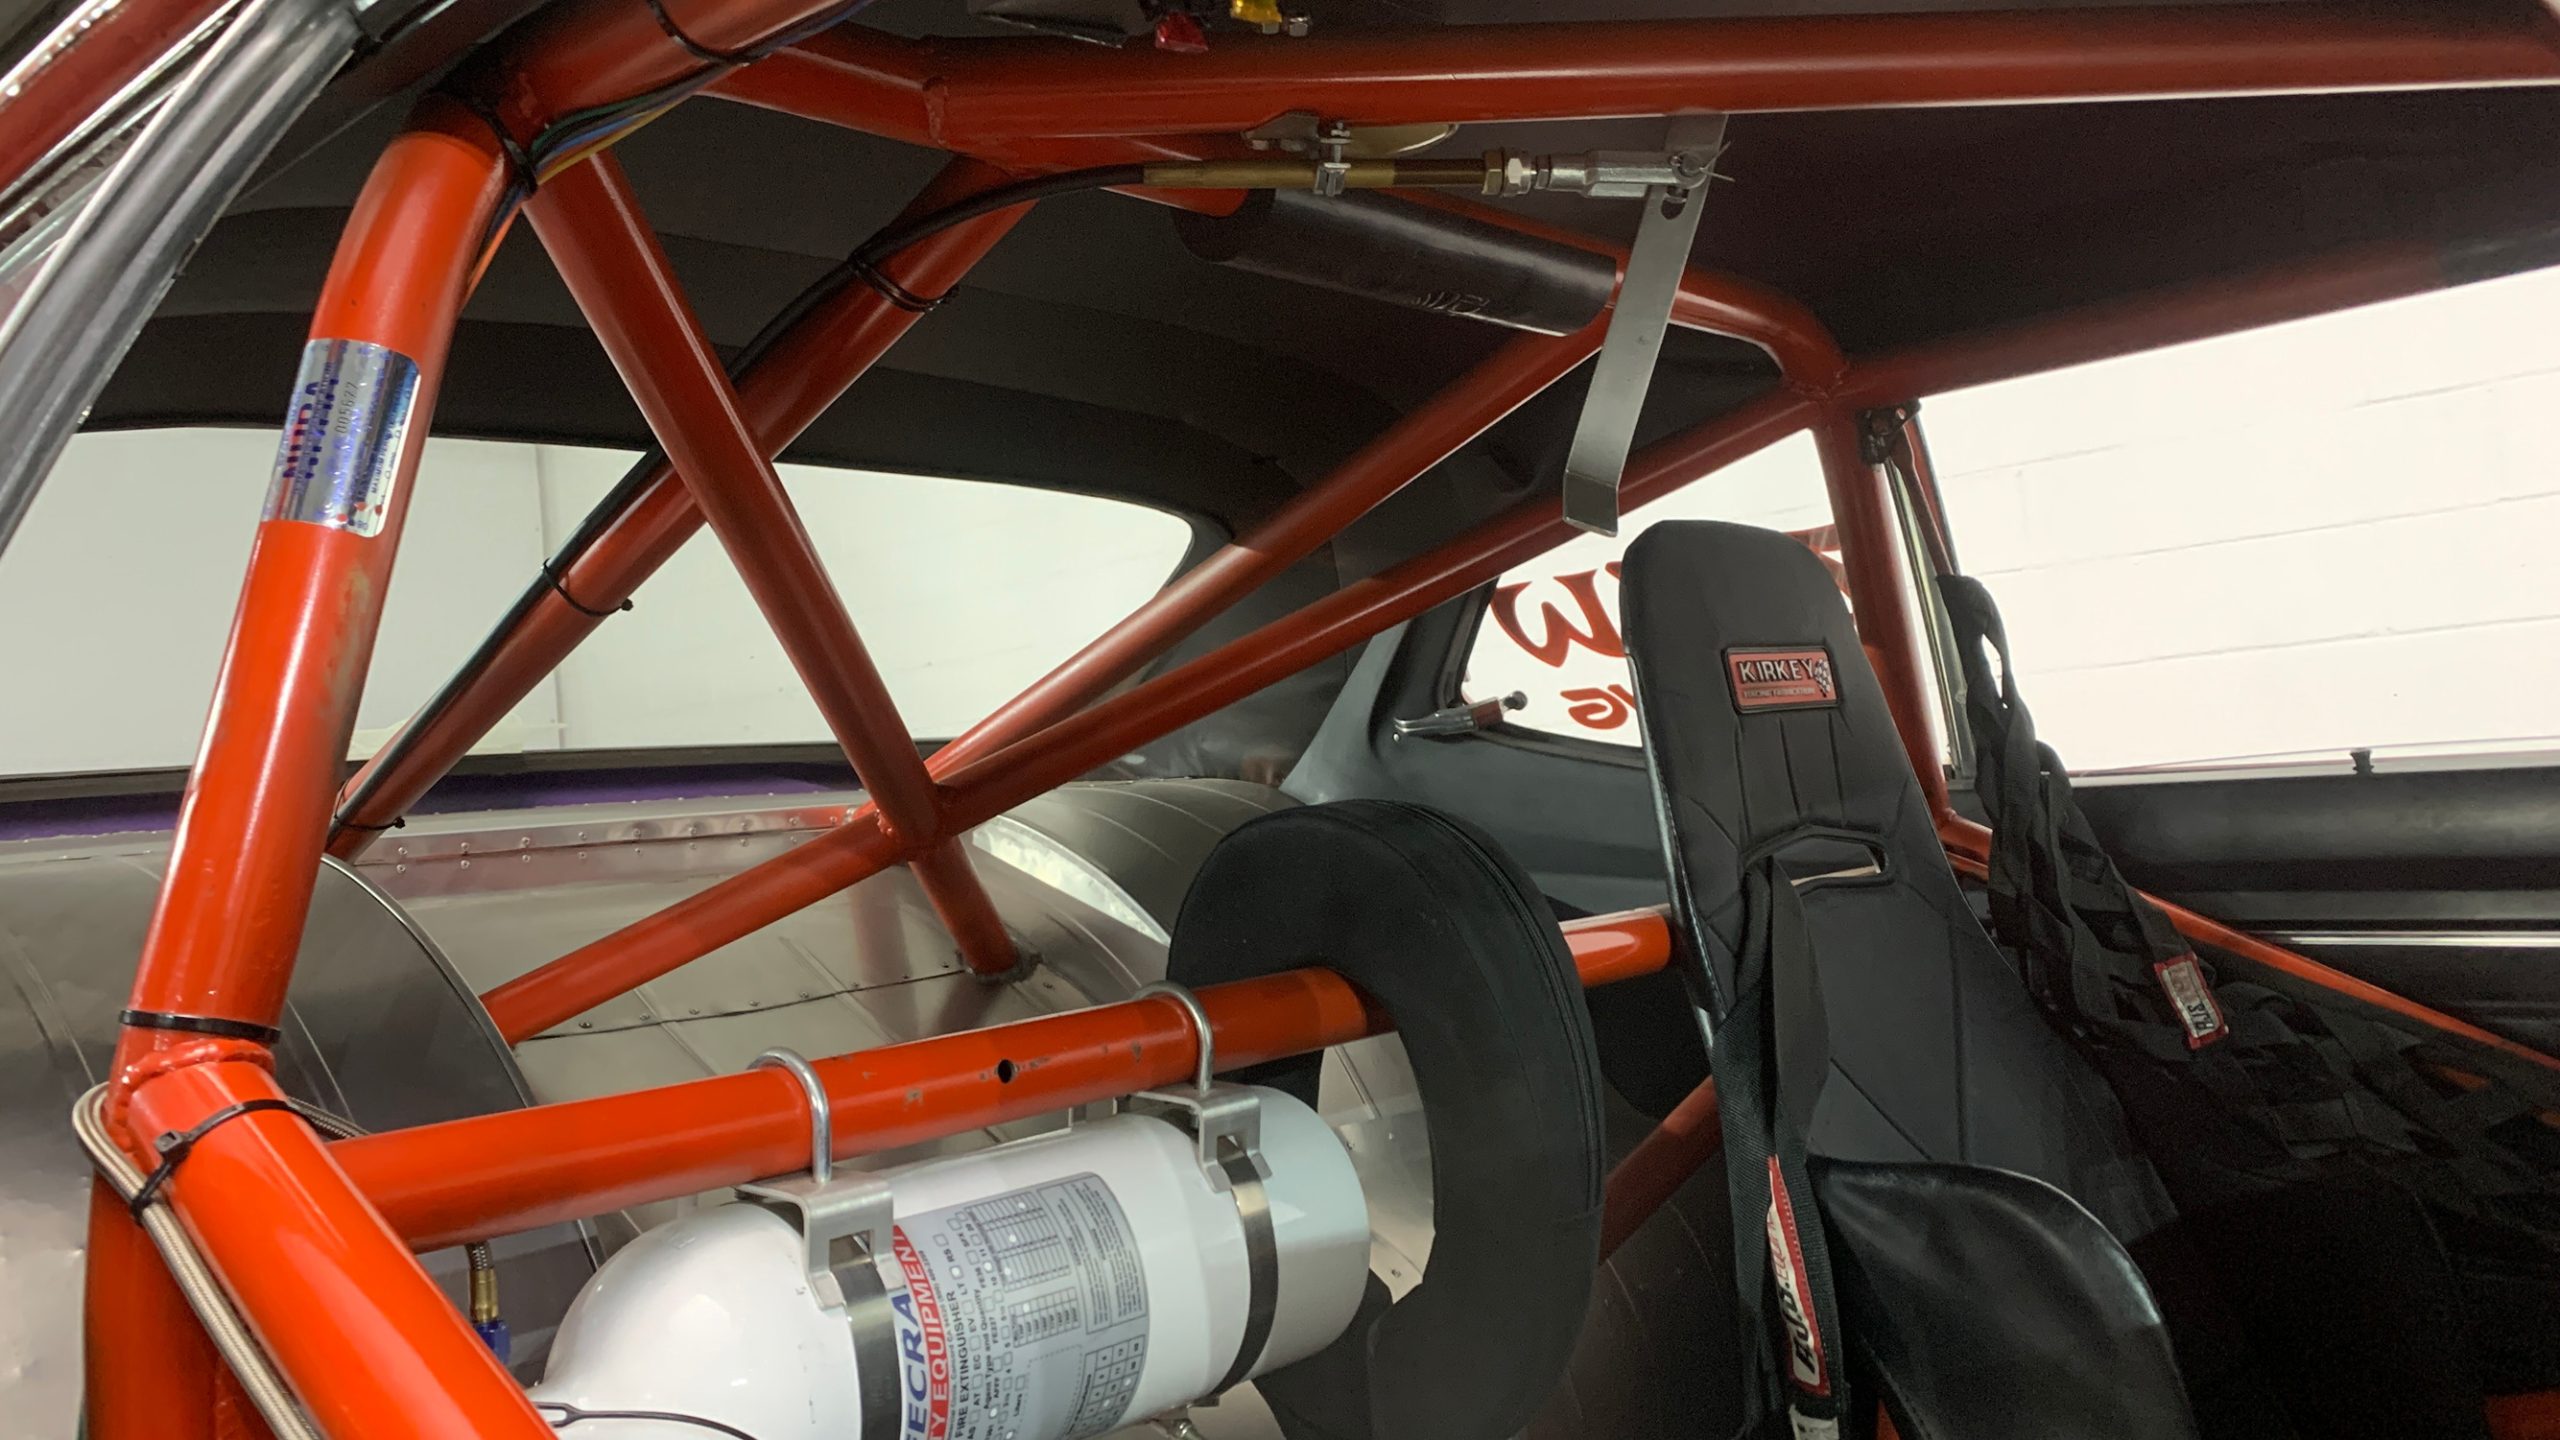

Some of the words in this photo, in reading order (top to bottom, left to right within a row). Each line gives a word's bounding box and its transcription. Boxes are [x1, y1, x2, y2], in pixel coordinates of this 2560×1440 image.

[1738, 659, 1814, 683] KIRKEY
[943, 1248, 955, 1262] RS
[956, 1282, 968, 1296] LT
[974, 1289, 987, 1331] Quantity
[967, 1317, 977, 1333] EV
[946, 1290, 970, 1403] EXTINGUISHER
[982, 1333, 991, 1351] and
[892, 1293, 928, 1440] ECRA
[973, 1354, 981, 1370] EC
[985, 1355, 995, 1378] Type
[973, 1393, 981, 1406] AT
[983, 1381, 993, 1409] Agent
[955, 1406, 969, 1438] FIRE
